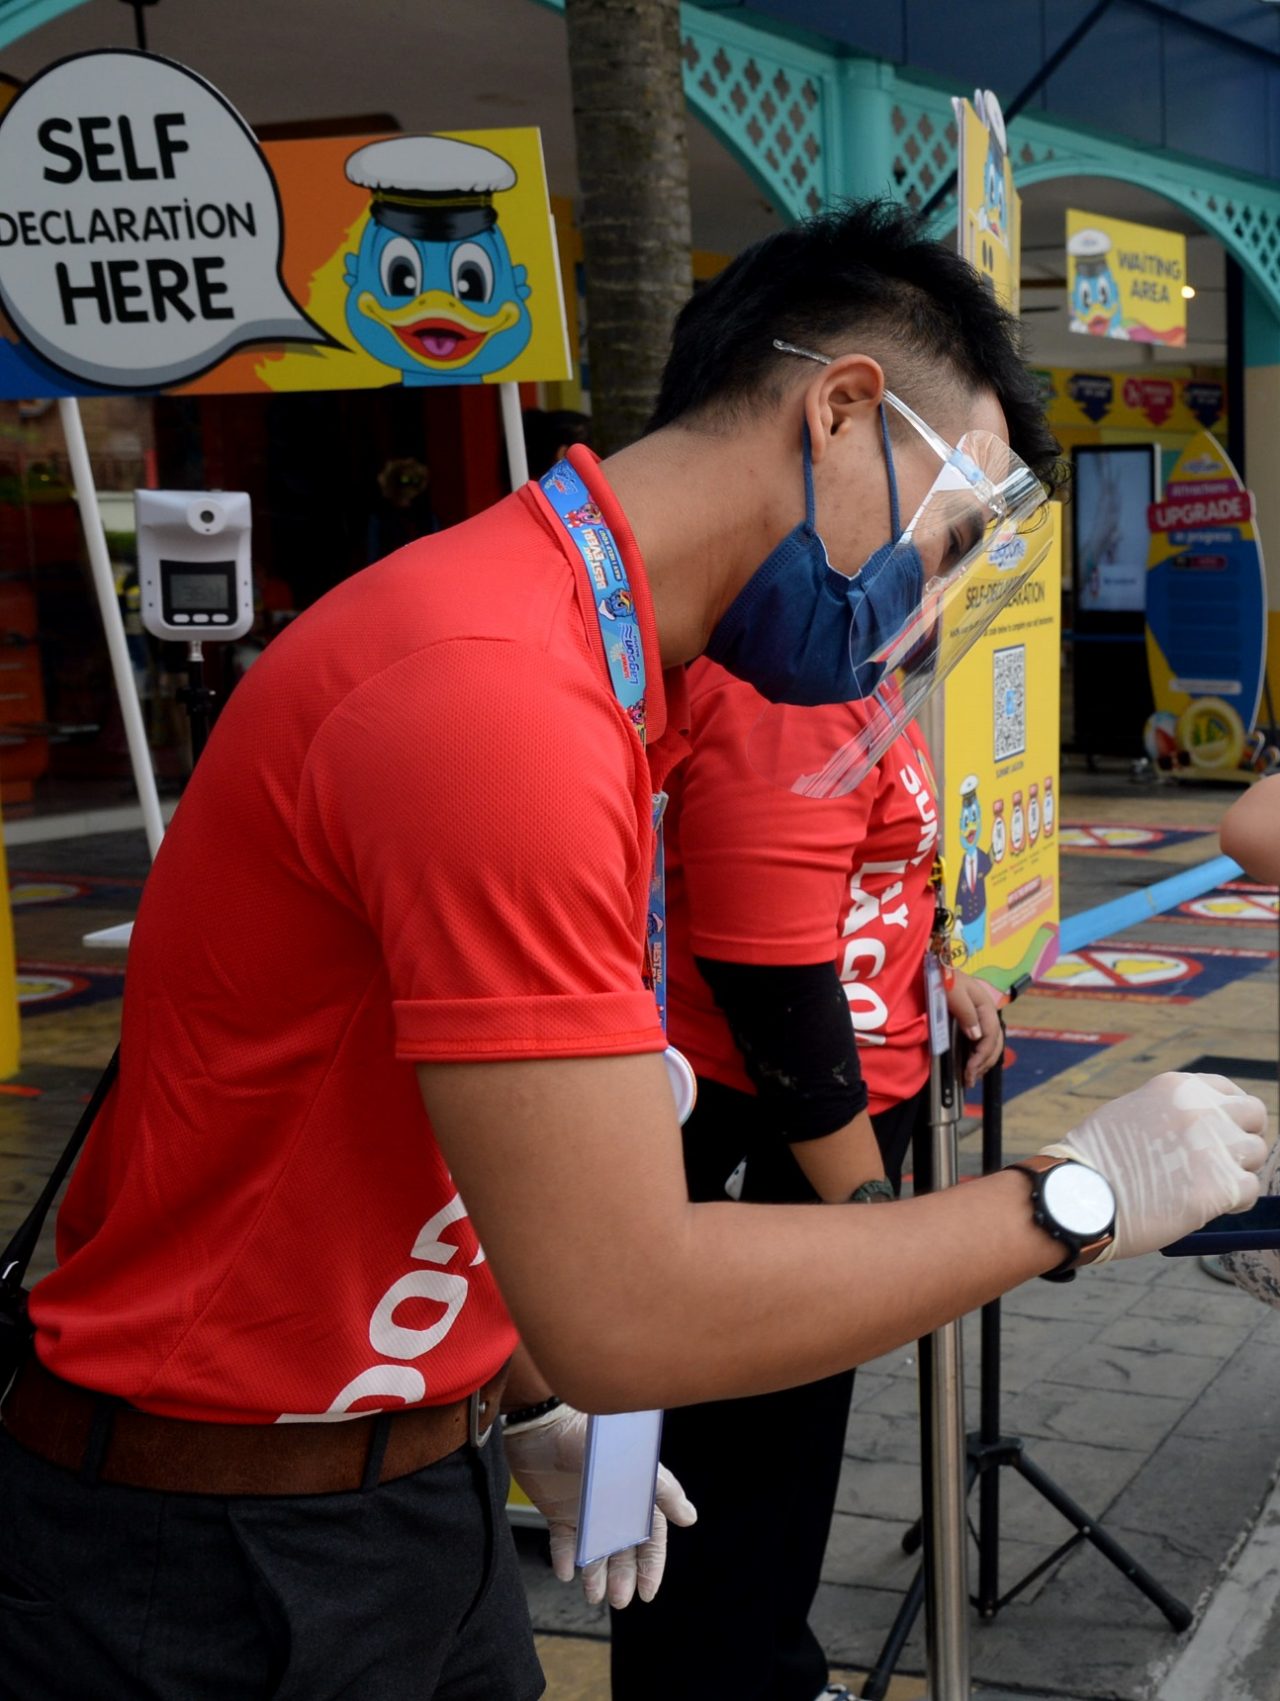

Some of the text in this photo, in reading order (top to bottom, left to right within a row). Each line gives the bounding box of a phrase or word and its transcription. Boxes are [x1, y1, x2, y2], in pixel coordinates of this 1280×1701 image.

[37, 112, 190, 185] SELF
[55, 256, 236, 326] HERE
[1130, 279, 1171, 304] AREA
[1154, 496, 1243, 529] UPGRADE
[965, 578, 1046, 611] SELF-DECARATION
